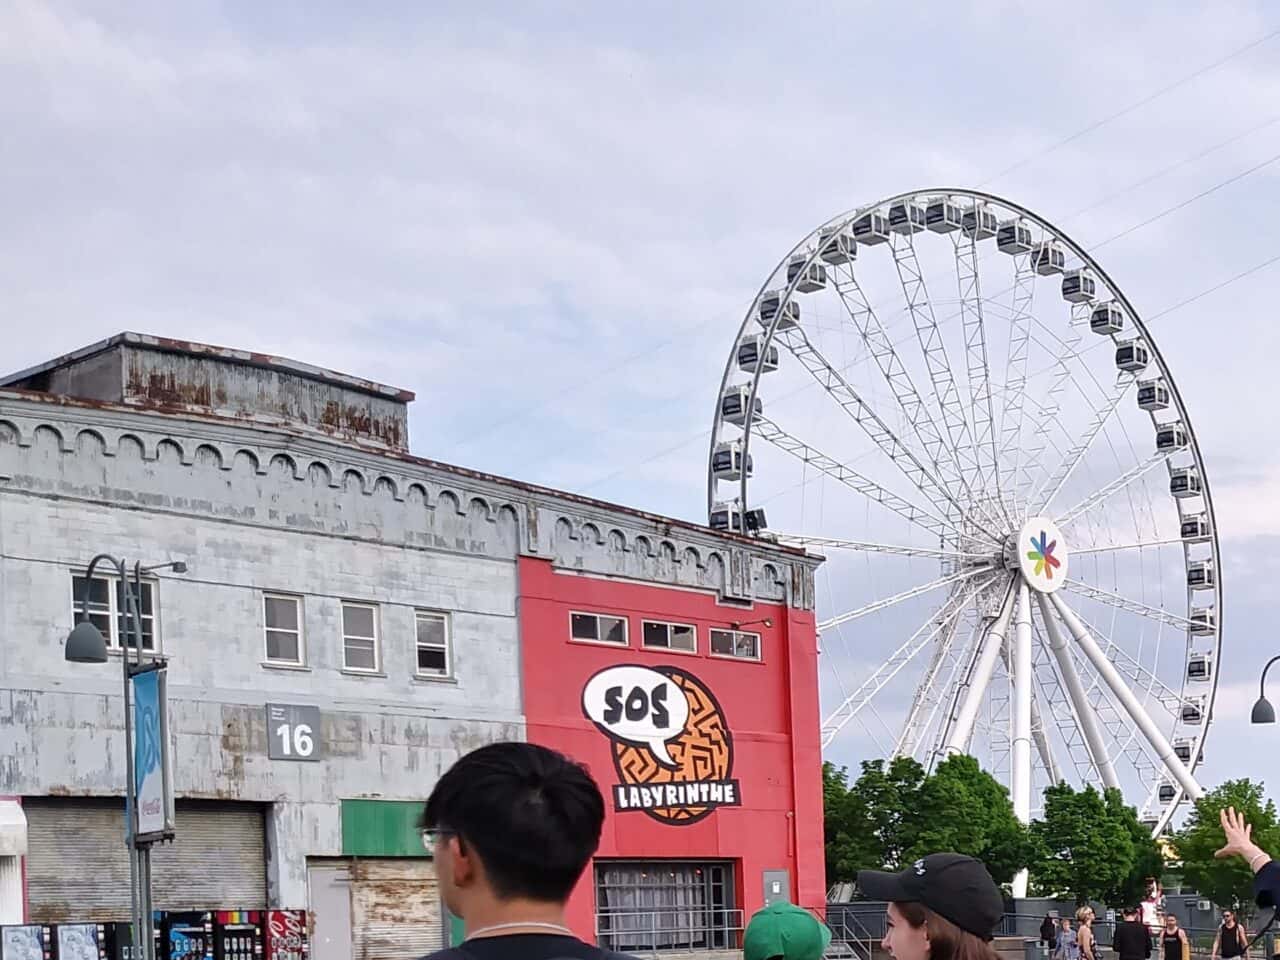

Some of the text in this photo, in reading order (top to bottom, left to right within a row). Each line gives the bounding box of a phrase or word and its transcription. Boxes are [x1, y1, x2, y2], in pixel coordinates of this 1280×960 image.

[603, 683, 670, 729] SOS
[277, 724, 313, 756] 16
[618, 784, 736, 810] LABYRINTHE
